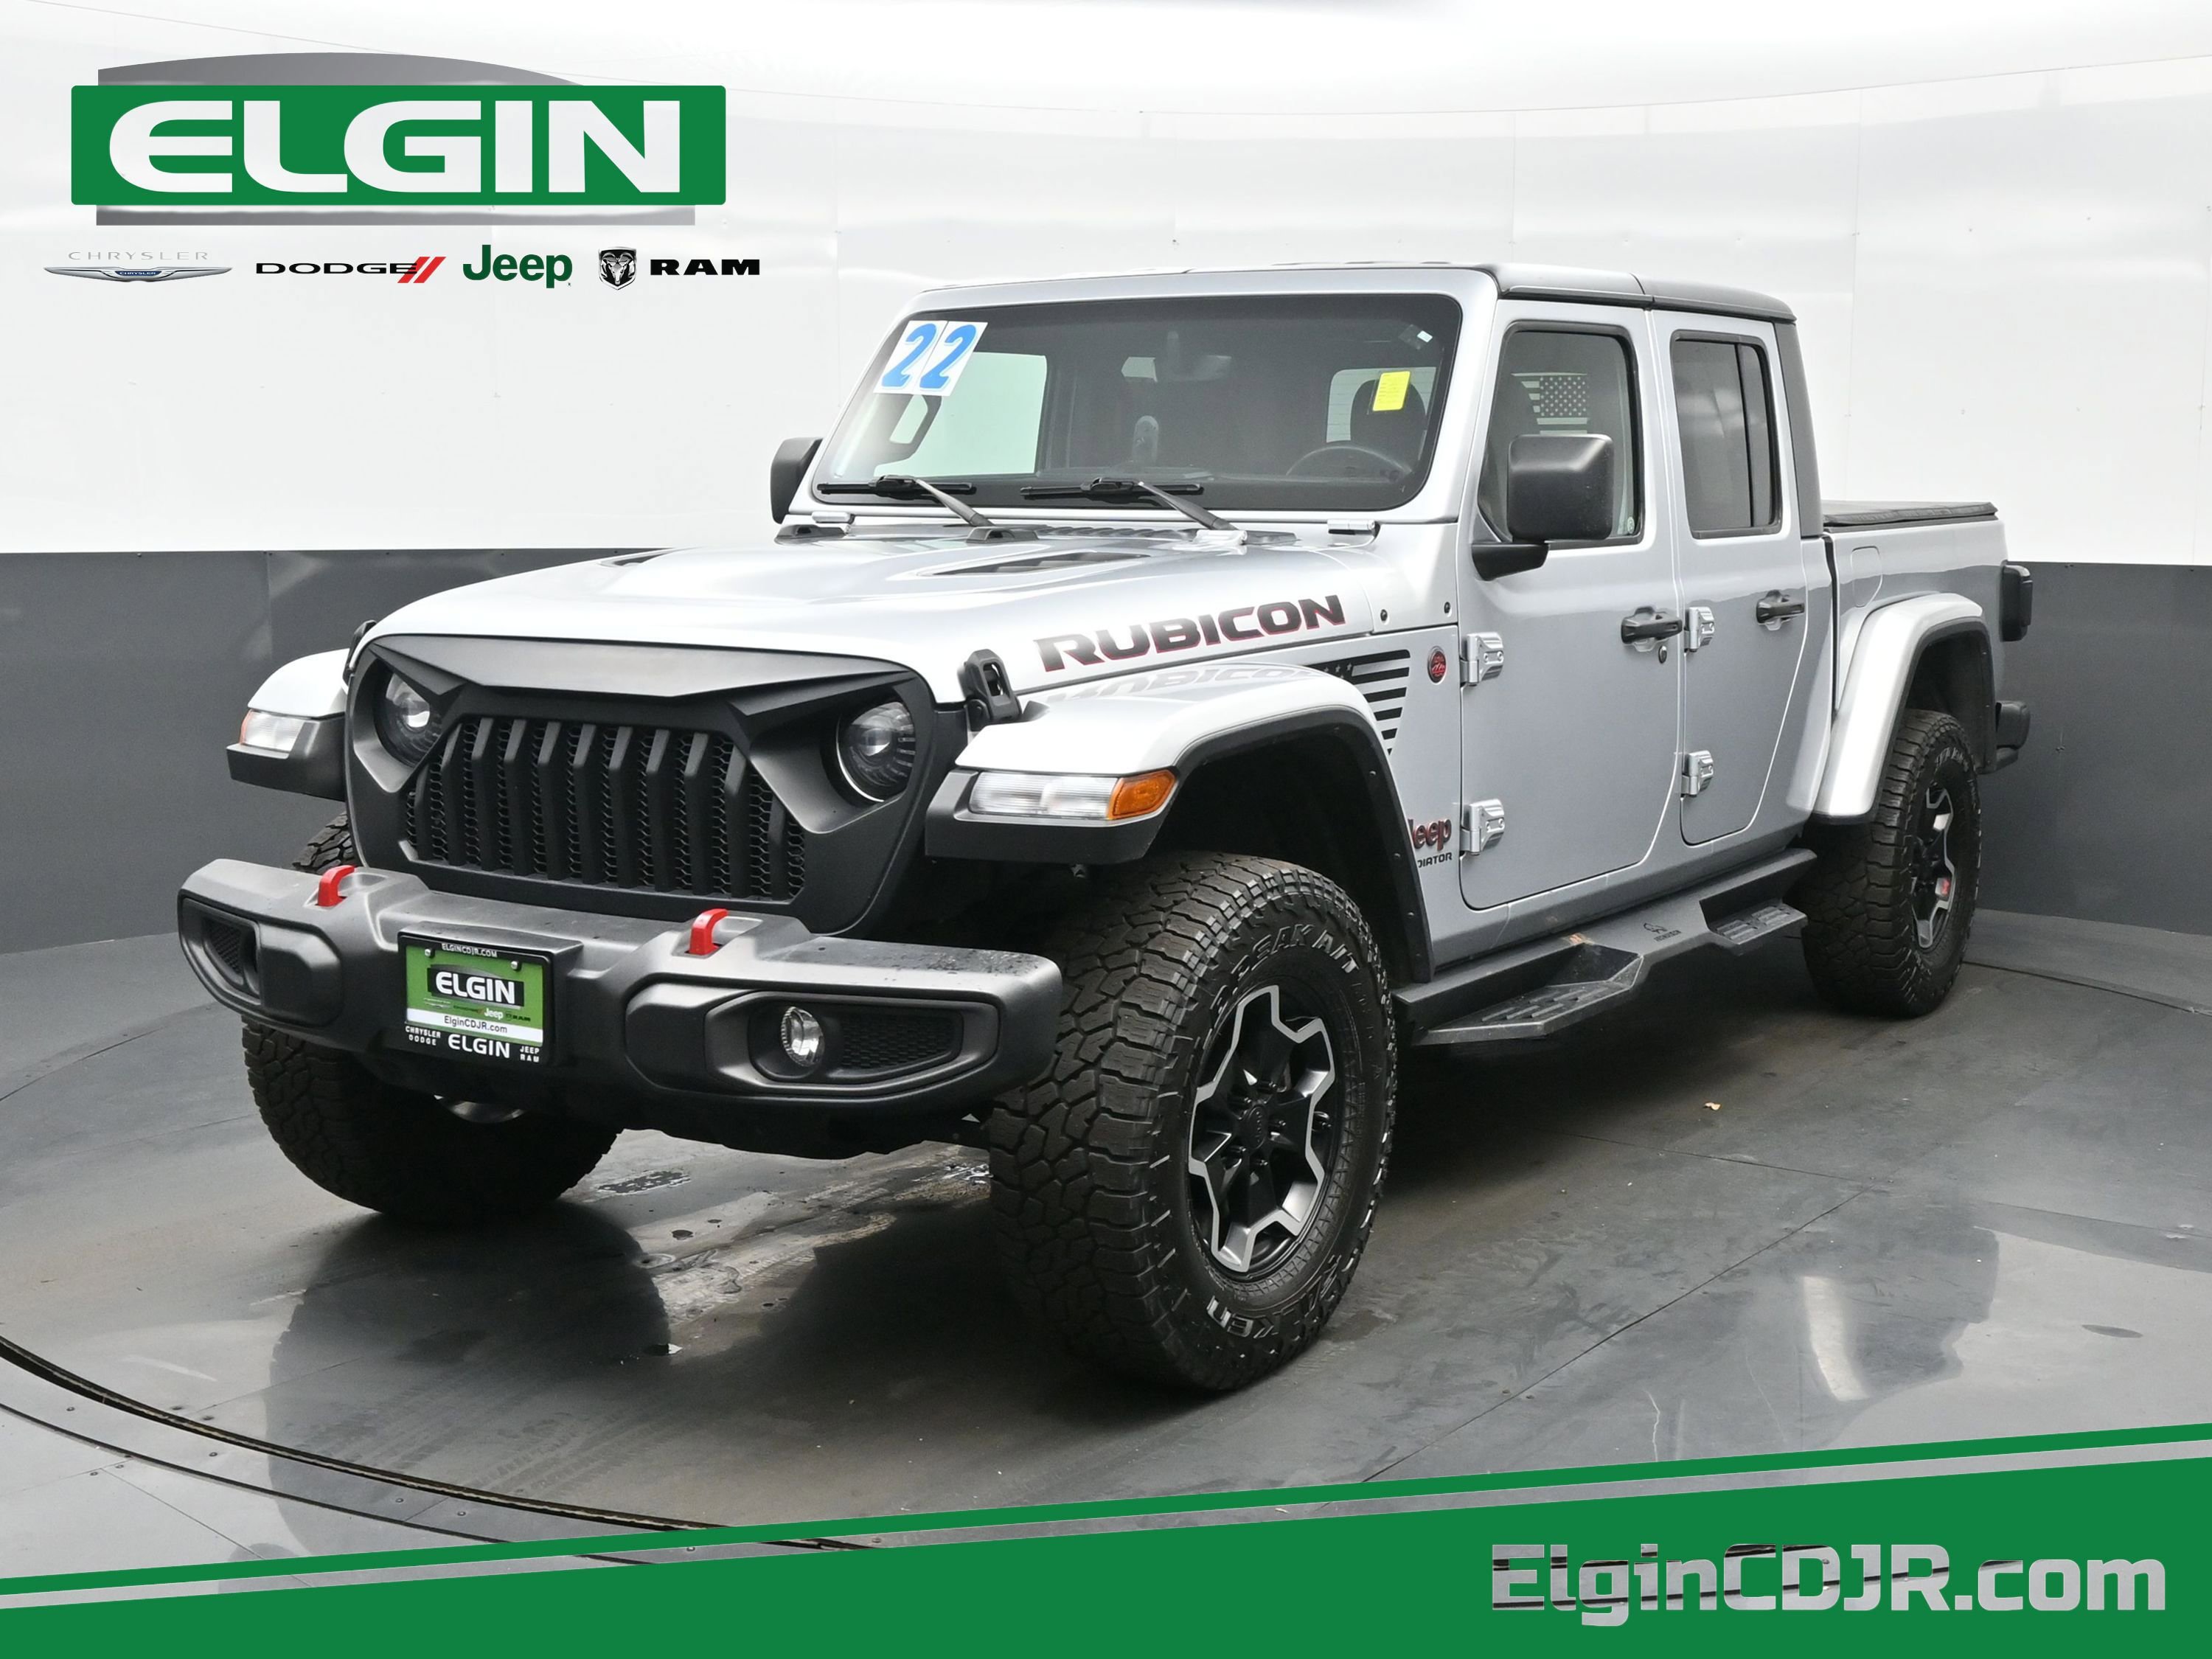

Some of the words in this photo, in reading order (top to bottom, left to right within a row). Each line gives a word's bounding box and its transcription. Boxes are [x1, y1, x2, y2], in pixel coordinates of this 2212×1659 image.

[881, 323, 976, 389] 22
[1033, 594, 1346, 672] RUBICON
[442, 943, 498, 959] ELGINCDJR.COM
[435, 970, 515, 1005] ELGIN
[484, 1008, 504, 1020] Jeep
[405, 1025, 441, 1039] CHRYSLER
[444, 1015, 508, 1034] ElginCDJR.com
[408, 1034, 437, 1046] DODGE
[448, 1033, 510, 1059] ELGIN
[519, 1046, 540, 1054] JEEP
[520, 1053, 540, 1063] RAM
